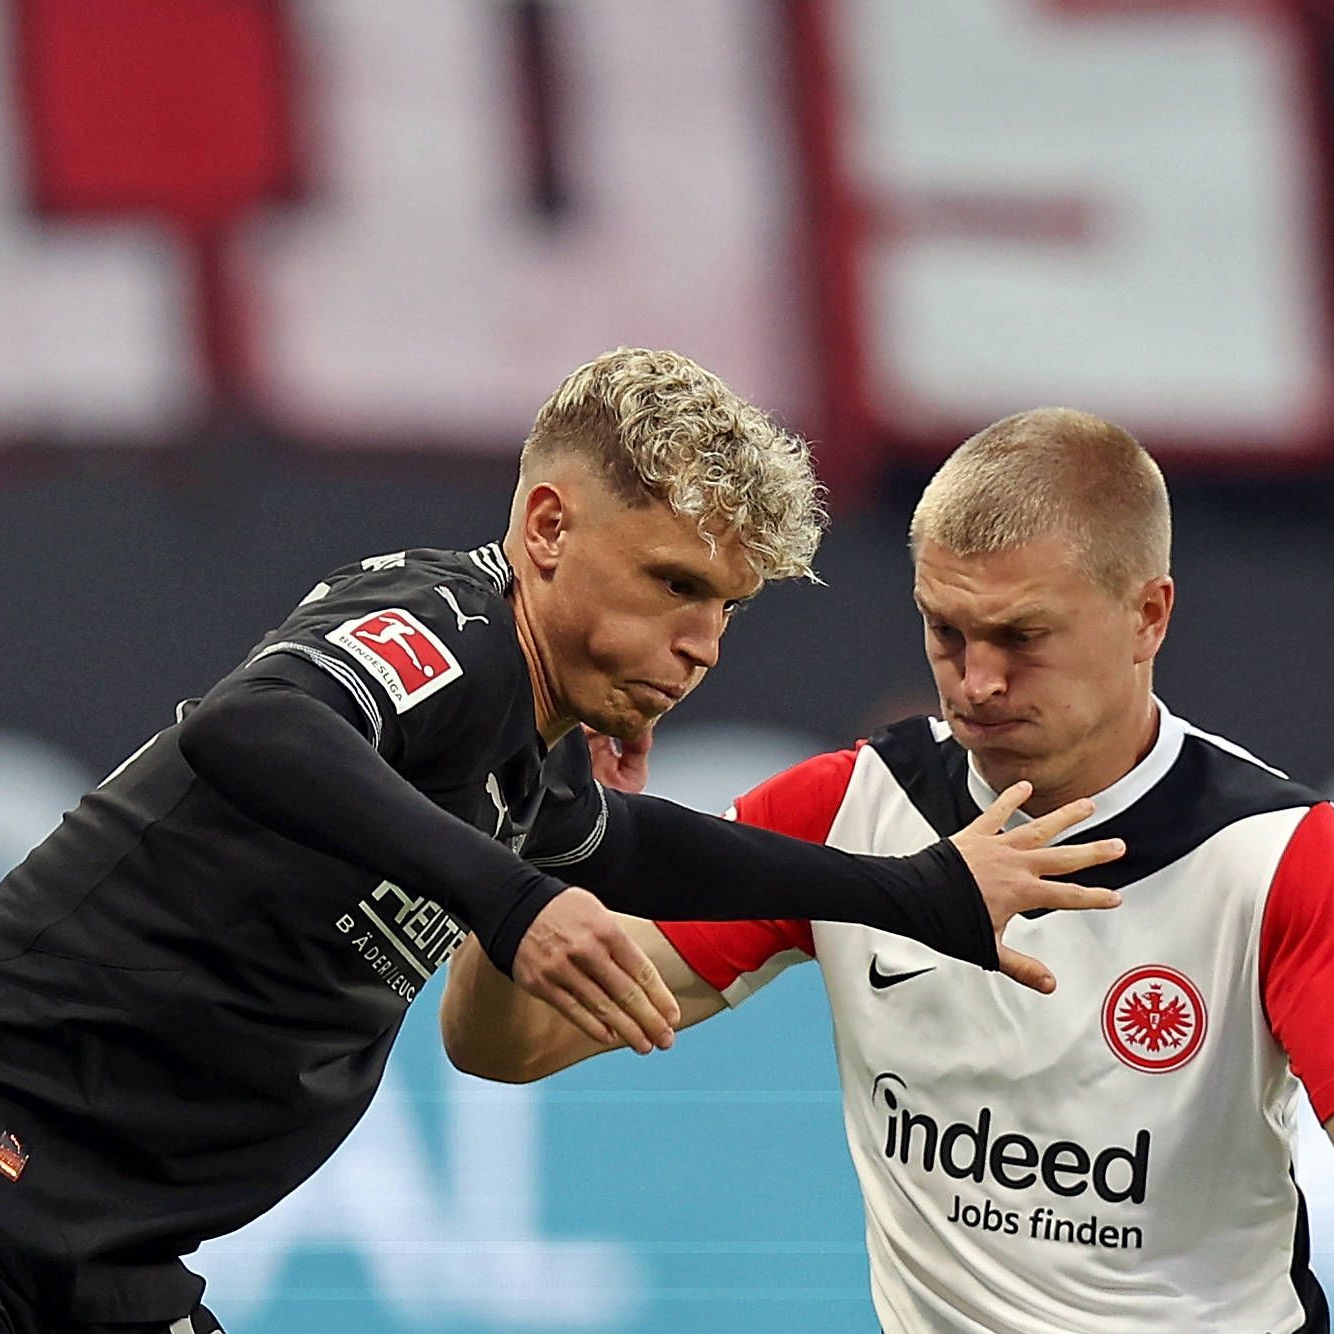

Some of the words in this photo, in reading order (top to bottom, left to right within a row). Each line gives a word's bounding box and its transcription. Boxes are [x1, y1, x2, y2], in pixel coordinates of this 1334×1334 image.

[338, 635, 403, 702] BUNDESLIGA
[872, 1072, 1151, 1205] indeed
[947, 1195, 1019, 1236] Jobs
[1029, 1207, 1143, 1250] finden
